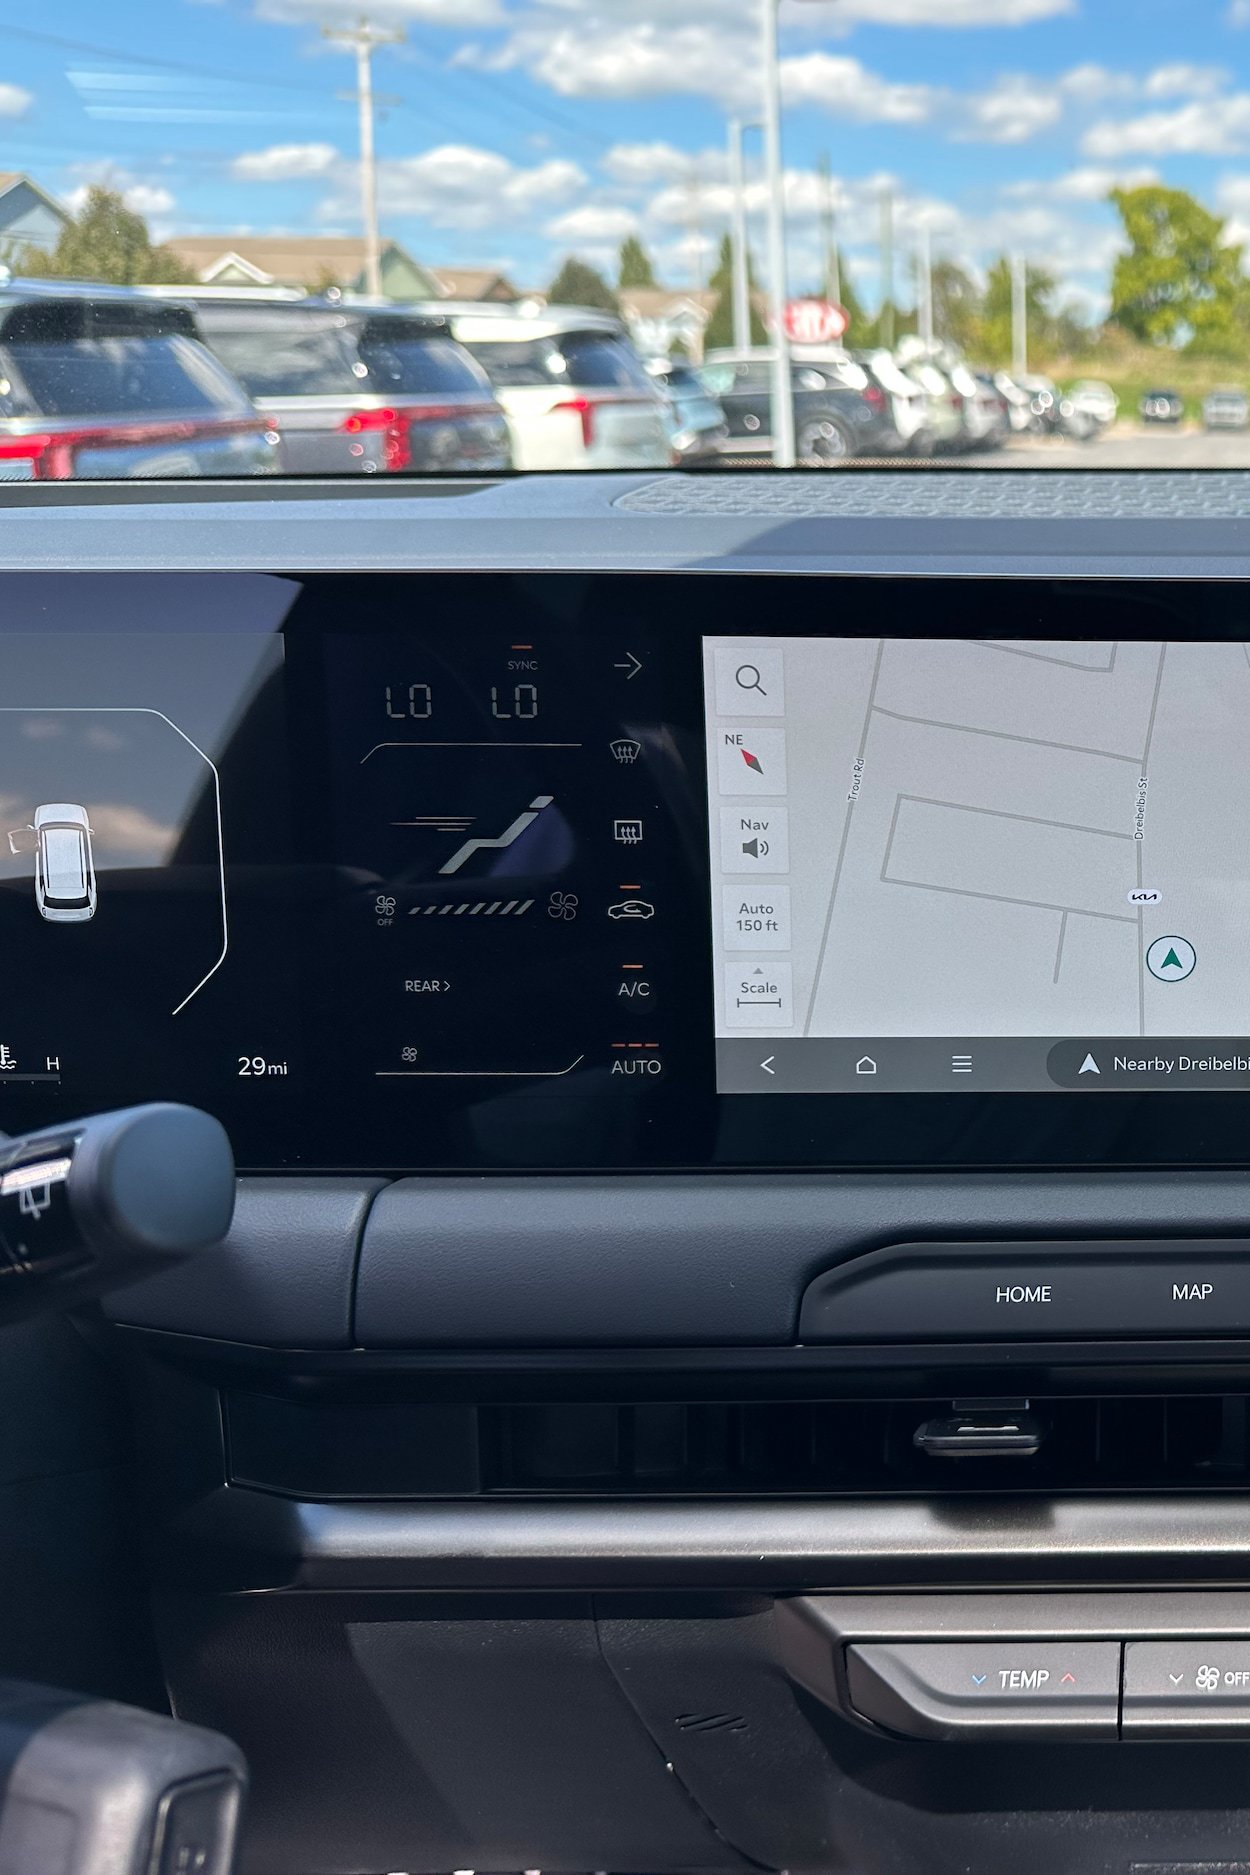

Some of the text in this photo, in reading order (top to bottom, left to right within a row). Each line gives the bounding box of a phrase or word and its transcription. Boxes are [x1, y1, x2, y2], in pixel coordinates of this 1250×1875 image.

[507, 660, 538, 671] SYNC
[724, 734, 744, 746] NE
[847, 757, 865, 800] Trout Rd
[1134, 777, 1148, 840] Dreibelbis St
[740, 818, 769, 831] Nav
[739, 902, 774, 915] Auto
[377, 917, 394, 926] OFF
[736, 918, 778, 932] 150 ft
[404, 979, 441, 993] REAR
[618, 981, 650, 998] A/C
[740, 981, 778, 994] Scale
[46, 1056, 60, 1071] H
[237, 1056, 288, 1076] 29 mi
[611, 1059, 662, 1075] AUTO
[1114, 1056, 1175, 1075] Nearby
[996, 1285, 1052, 1303] HOME
[1172, 1284, 1213, 1300] MAP
[998, 1669, 1050, 1689] TEMP
[1223, 1670, 1250, 1686] OFF
